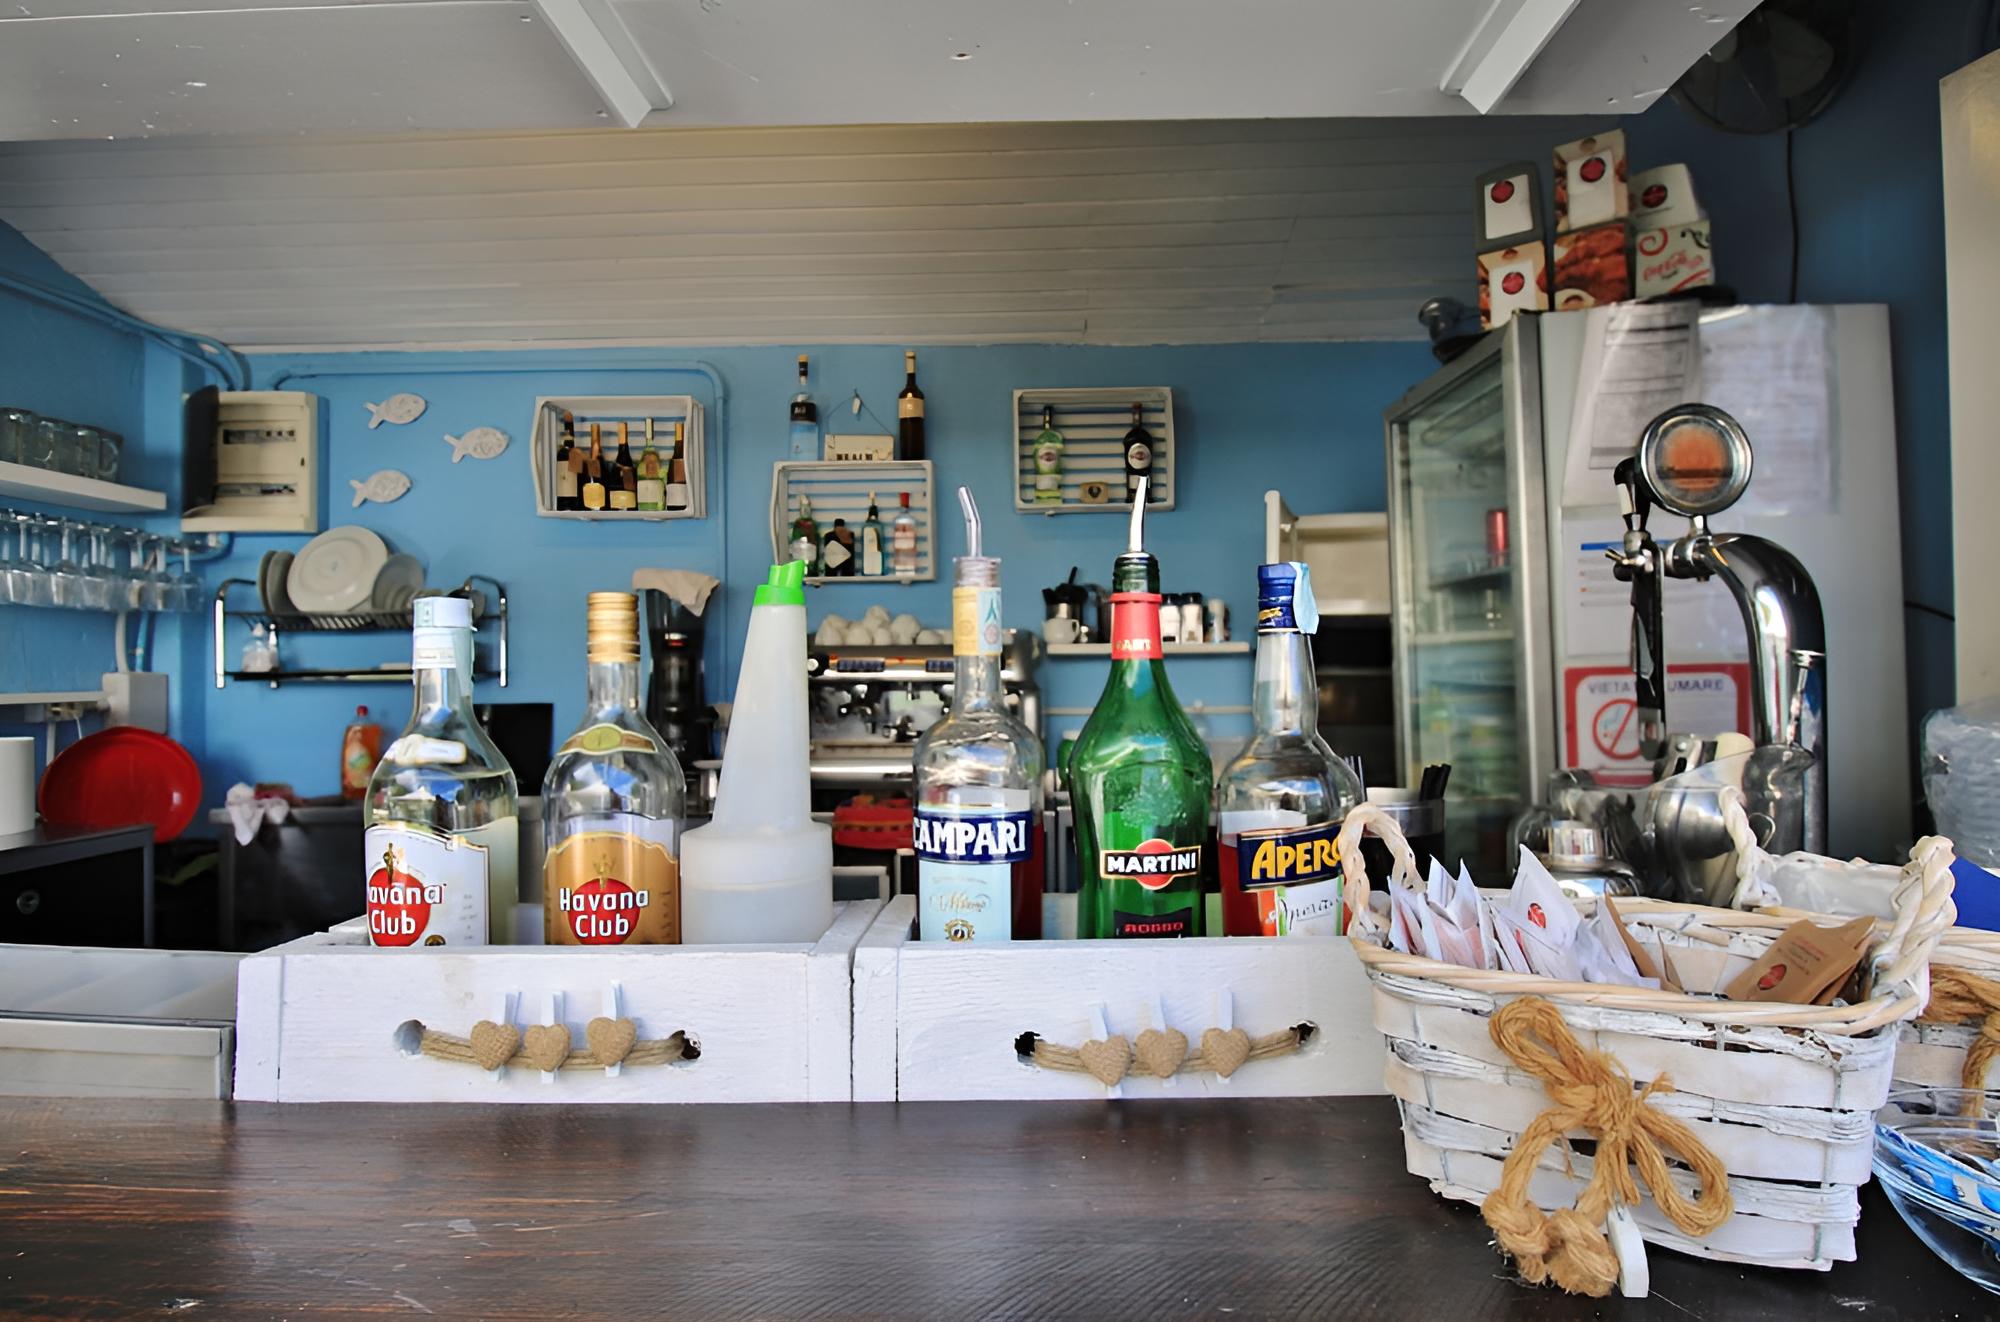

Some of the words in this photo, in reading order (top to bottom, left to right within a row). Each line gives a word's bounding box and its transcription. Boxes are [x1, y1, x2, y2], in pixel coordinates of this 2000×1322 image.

[1588, 680, 1638, 694] VIETA
[1667, 678, 1724, 693] UMARE
[1107, 852, 1197, 873] MARTINI
[368, 883, 447, 905] avana
[559, 887, 650, 912] Havana
[371, 909, 416, 935] Club
[575, 913, 630, 938] Club
